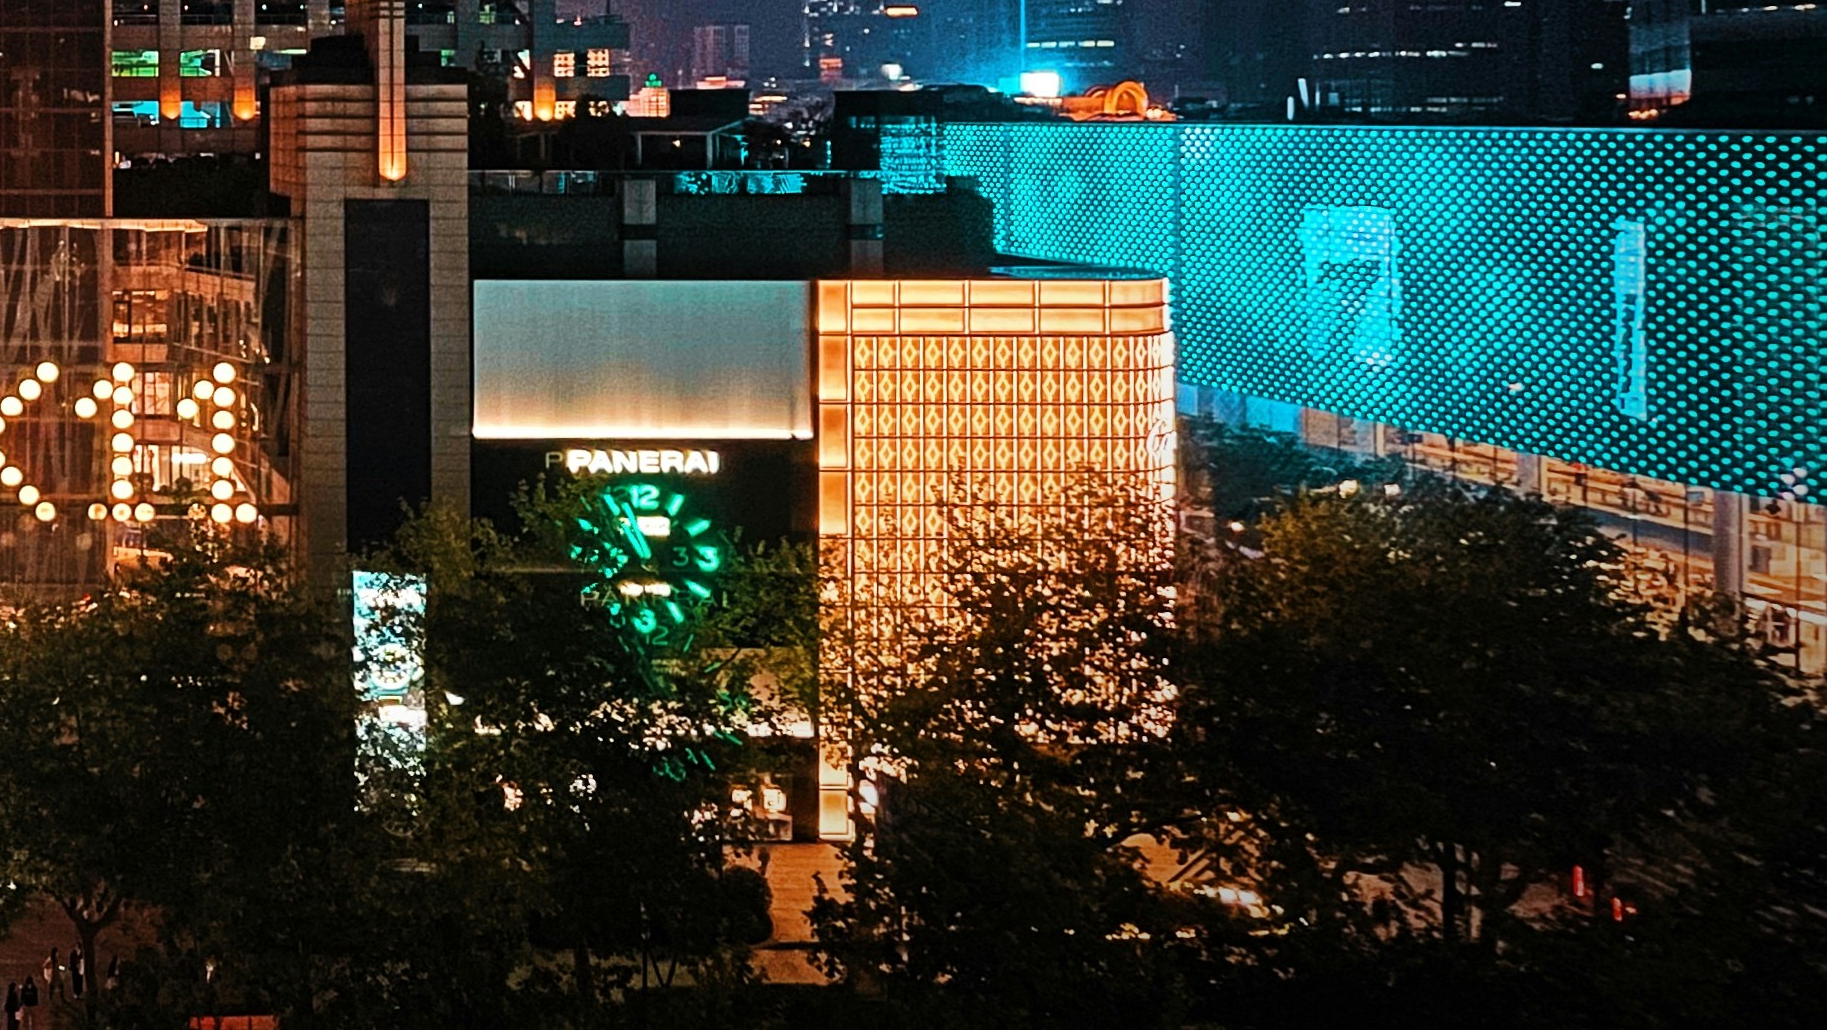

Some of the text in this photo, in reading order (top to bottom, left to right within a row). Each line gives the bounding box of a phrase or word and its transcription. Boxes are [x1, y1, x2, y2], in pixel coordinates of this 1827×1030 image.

[567, 450, 720, 474] PANERAI
[630, 484, 660, 509] 12
[694, 545, 721, 571] 3
